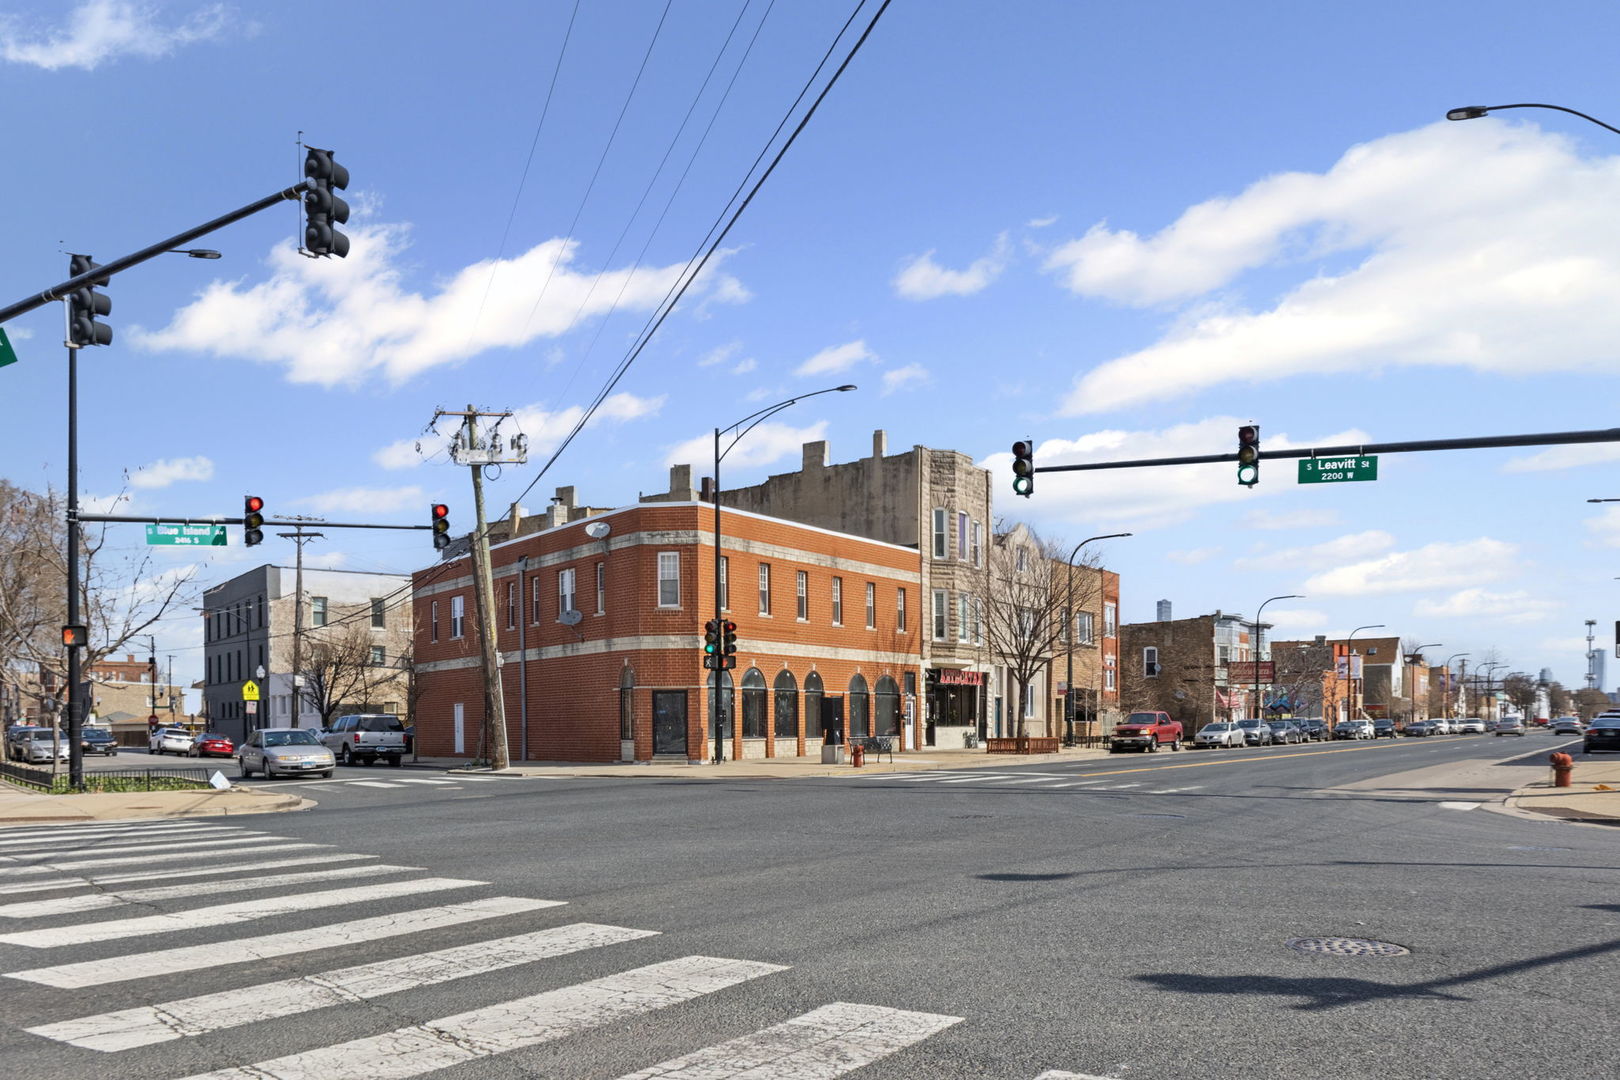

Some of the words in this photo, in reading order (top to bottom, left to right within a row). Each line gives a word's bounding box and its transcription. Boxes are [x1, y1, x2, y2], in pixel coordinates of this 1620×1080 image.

[1318, 458, 1356, 470] Leavitt
[1361, 460, 1370, 468] St
[1321, 472, 1343, 480] 2200
[157, 526, 179, 535] Blue
[183, 526, 211, 535] Island
